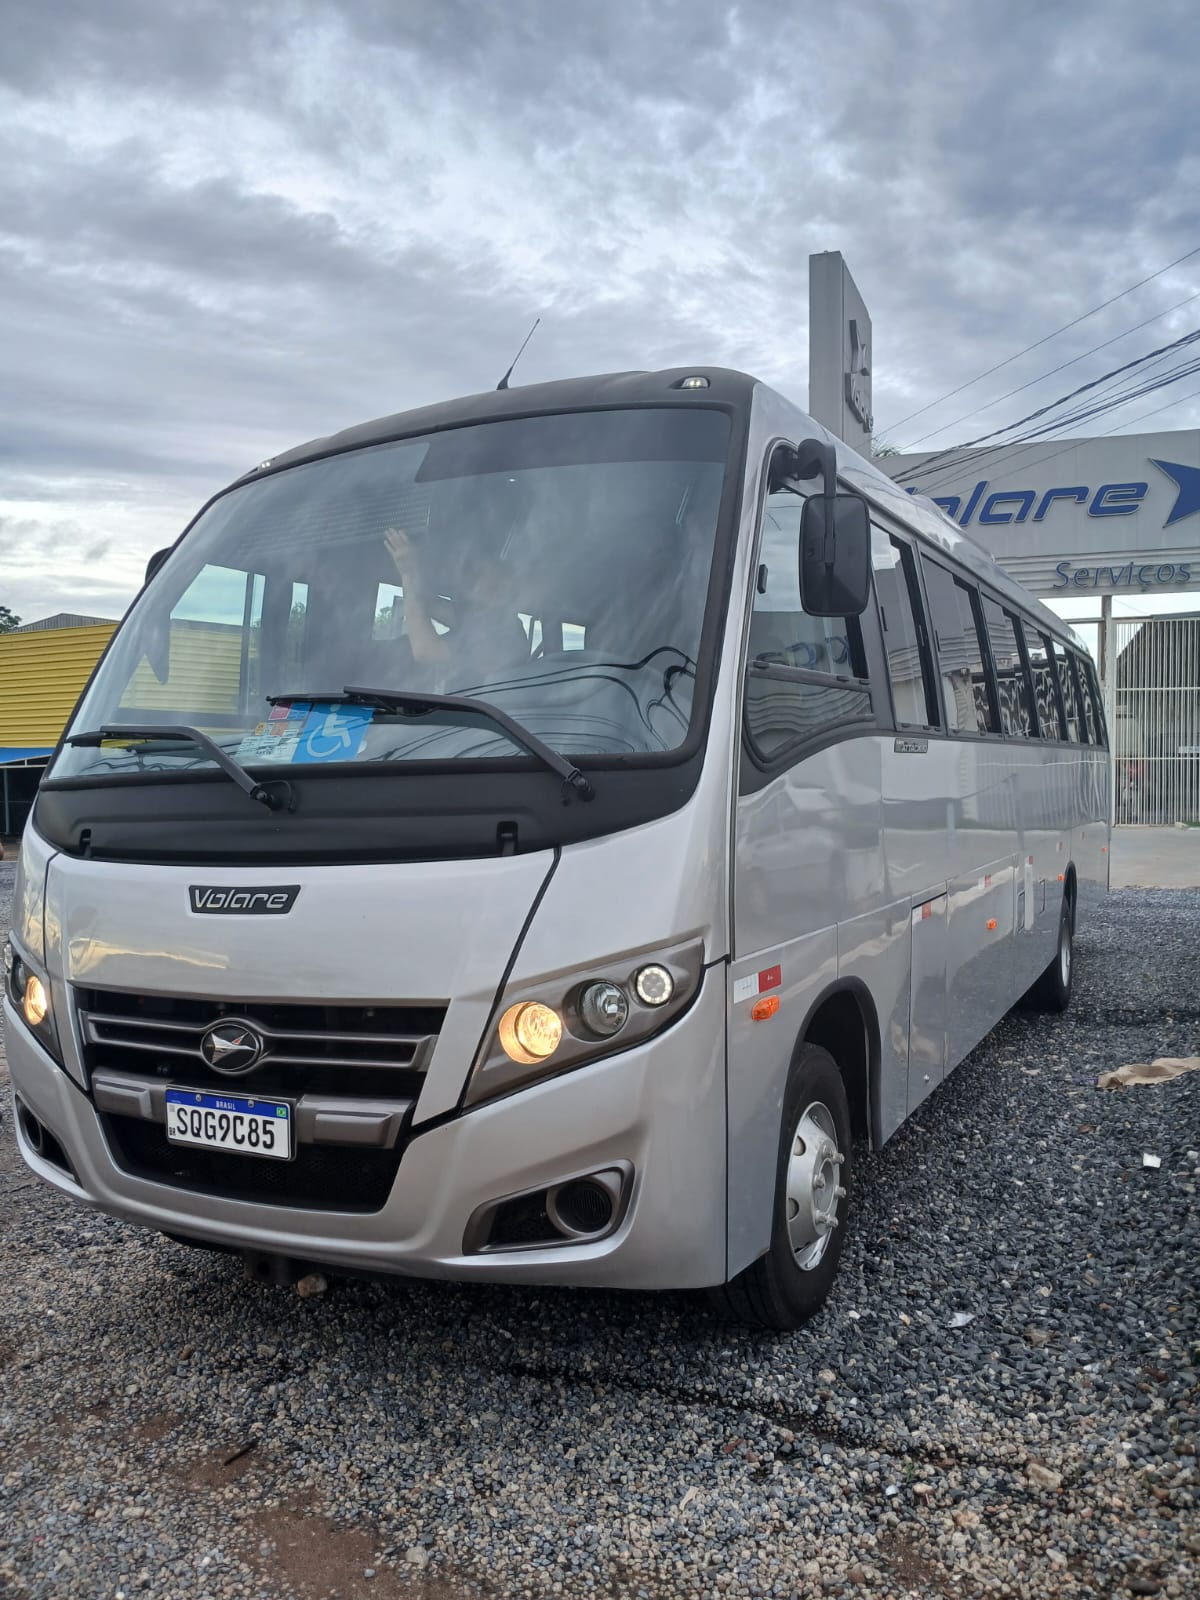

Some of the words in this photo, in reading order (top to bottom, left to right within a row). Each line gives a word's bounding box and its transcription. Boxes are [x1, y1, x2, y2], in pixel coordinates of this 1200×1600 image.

[904, 480, 1149, 527] lare
[1053, 561, 1192, 592] Serviços
[194, 889, 289, 909] Volare
[215, 1100, 236, 1111] BRASIL
[176, 1107, 275, 1149] SQG9C85
